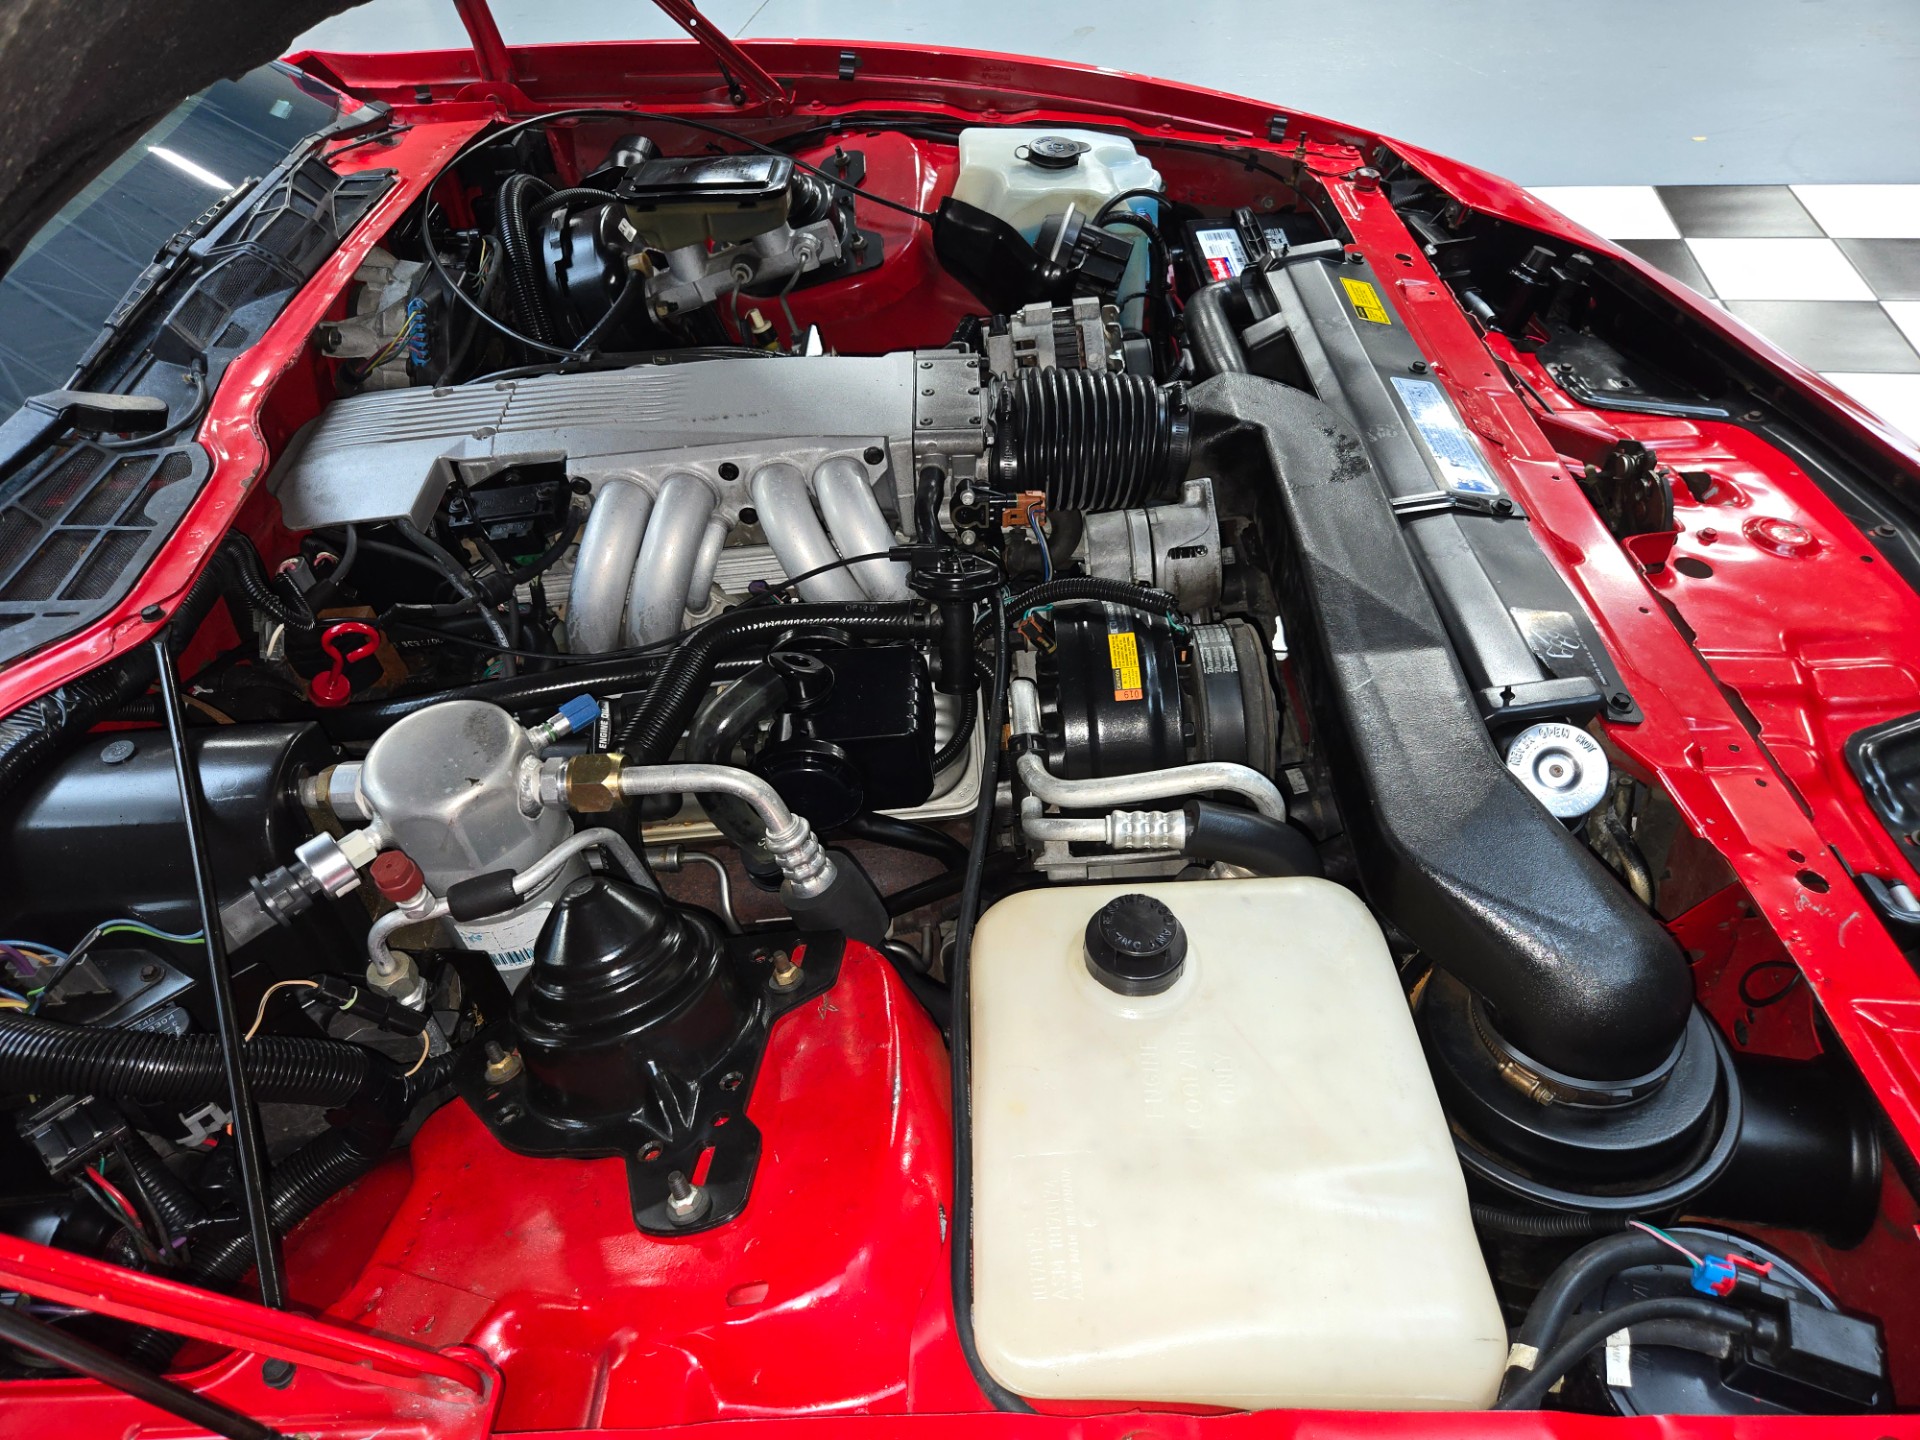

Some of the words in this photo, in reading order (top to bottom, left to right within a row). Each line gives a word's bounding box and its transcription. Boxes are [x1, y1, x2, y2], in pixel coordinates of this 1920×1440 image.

[1124, 690, 1140, 699] 019
[599, 720, 609, 749] ENGINE
[1538, 726, 1571, 740] OPEN
[1139, 1039, 1166, 1119] ENGINE
[1176, 1028, 1205, 1129] COOLANT
[1214, 1052, 1237, 1105] ONLY
